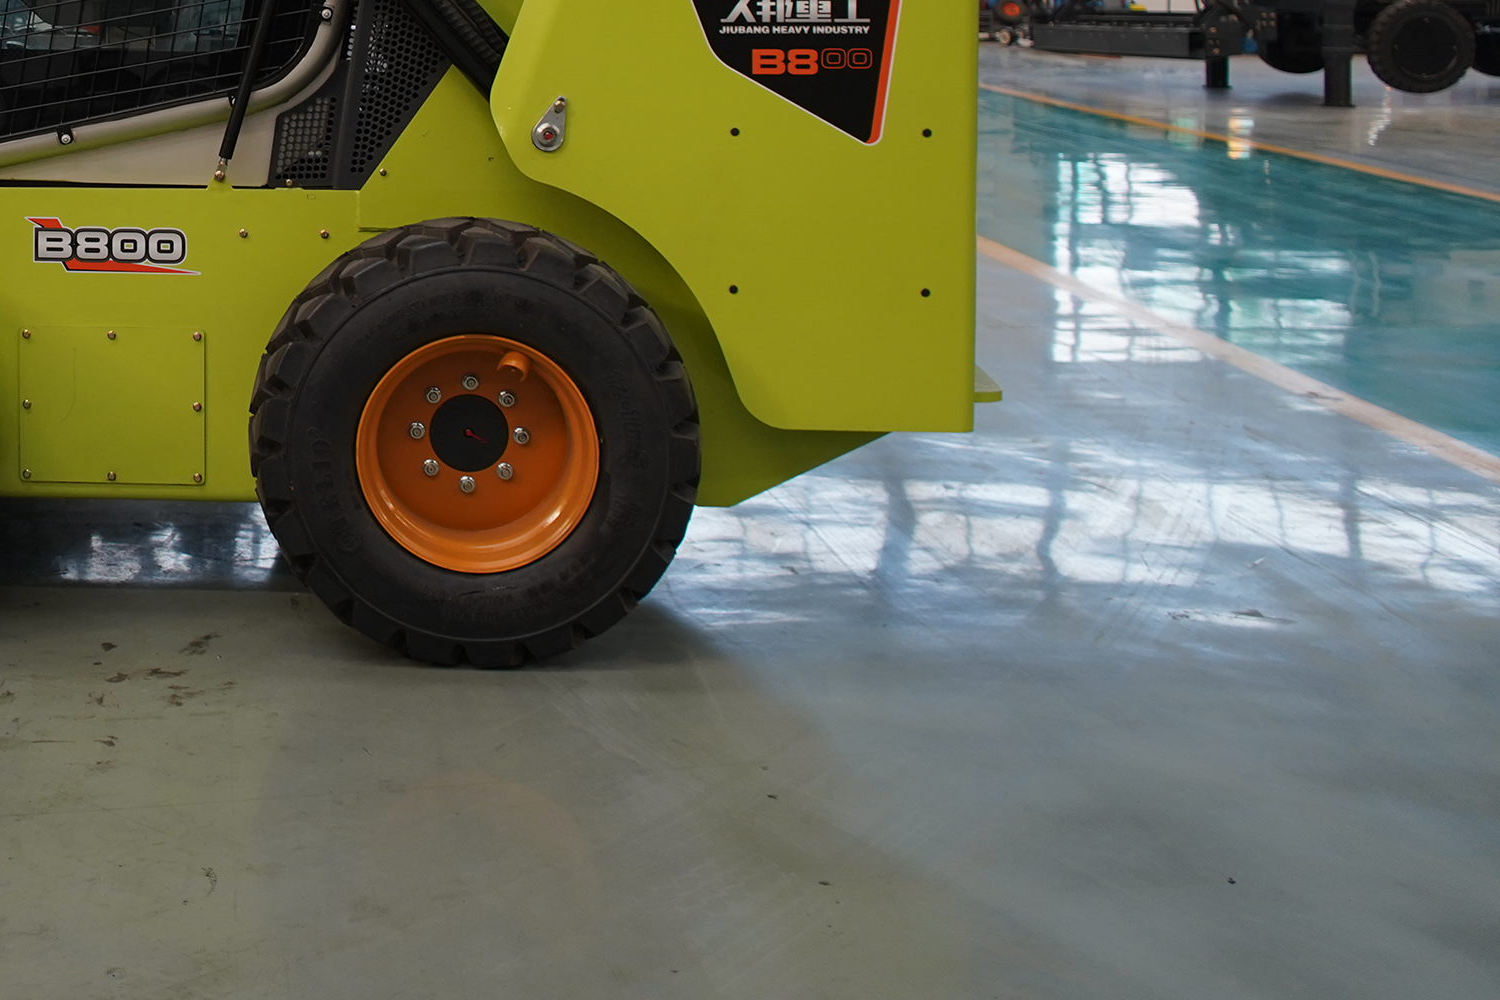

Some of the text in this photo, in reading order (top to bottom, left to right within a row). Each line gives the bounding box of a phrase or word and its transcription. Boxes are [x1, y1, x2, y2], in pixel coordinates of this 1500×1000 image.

[719, 26, 870, 34] JIUBANG HEAVY INDUSTRY
[751, 48, 873, 75] B800
[33, 226, 187, 265] B800
